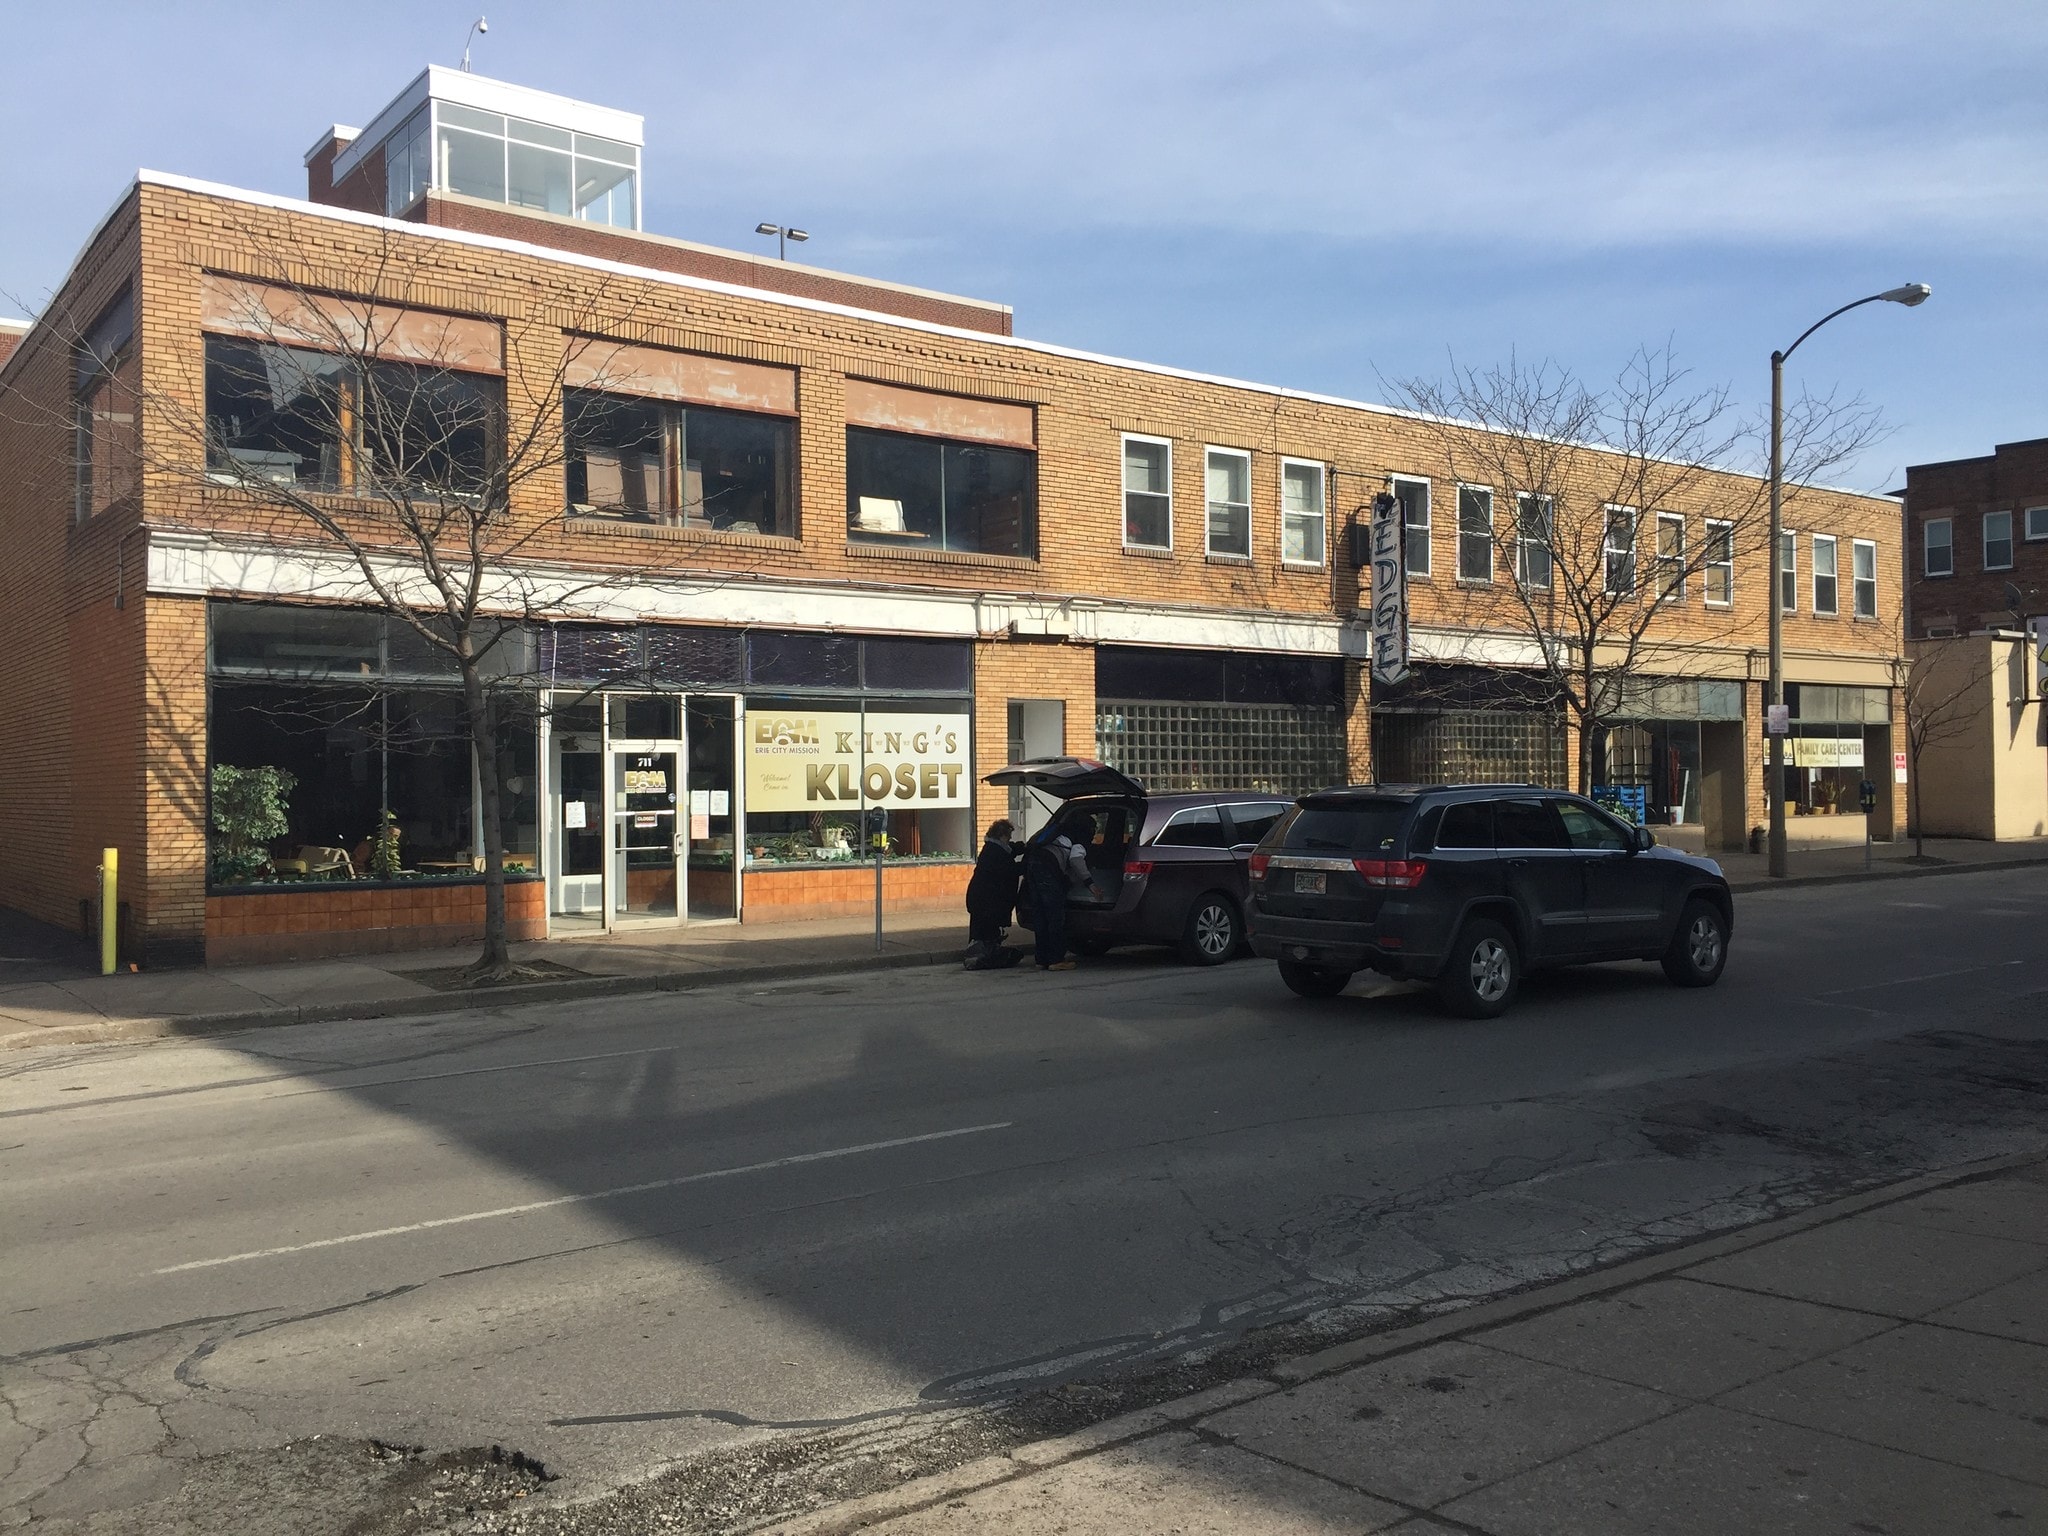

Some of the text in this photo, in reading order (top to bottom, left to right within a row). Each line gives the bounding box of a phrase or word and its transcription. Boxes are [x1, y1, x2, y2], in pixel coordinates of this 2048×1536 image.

[835, 725, 957, 754] KING'S
[1796, 743, 1819, 756] FAMILY
[1820, 743, 1837, 756] CARE
[1839, 743, 1862, 756] CENTER
[638, 757, 652, 767] 711
[806, 763, 962, 800] KLOSET
